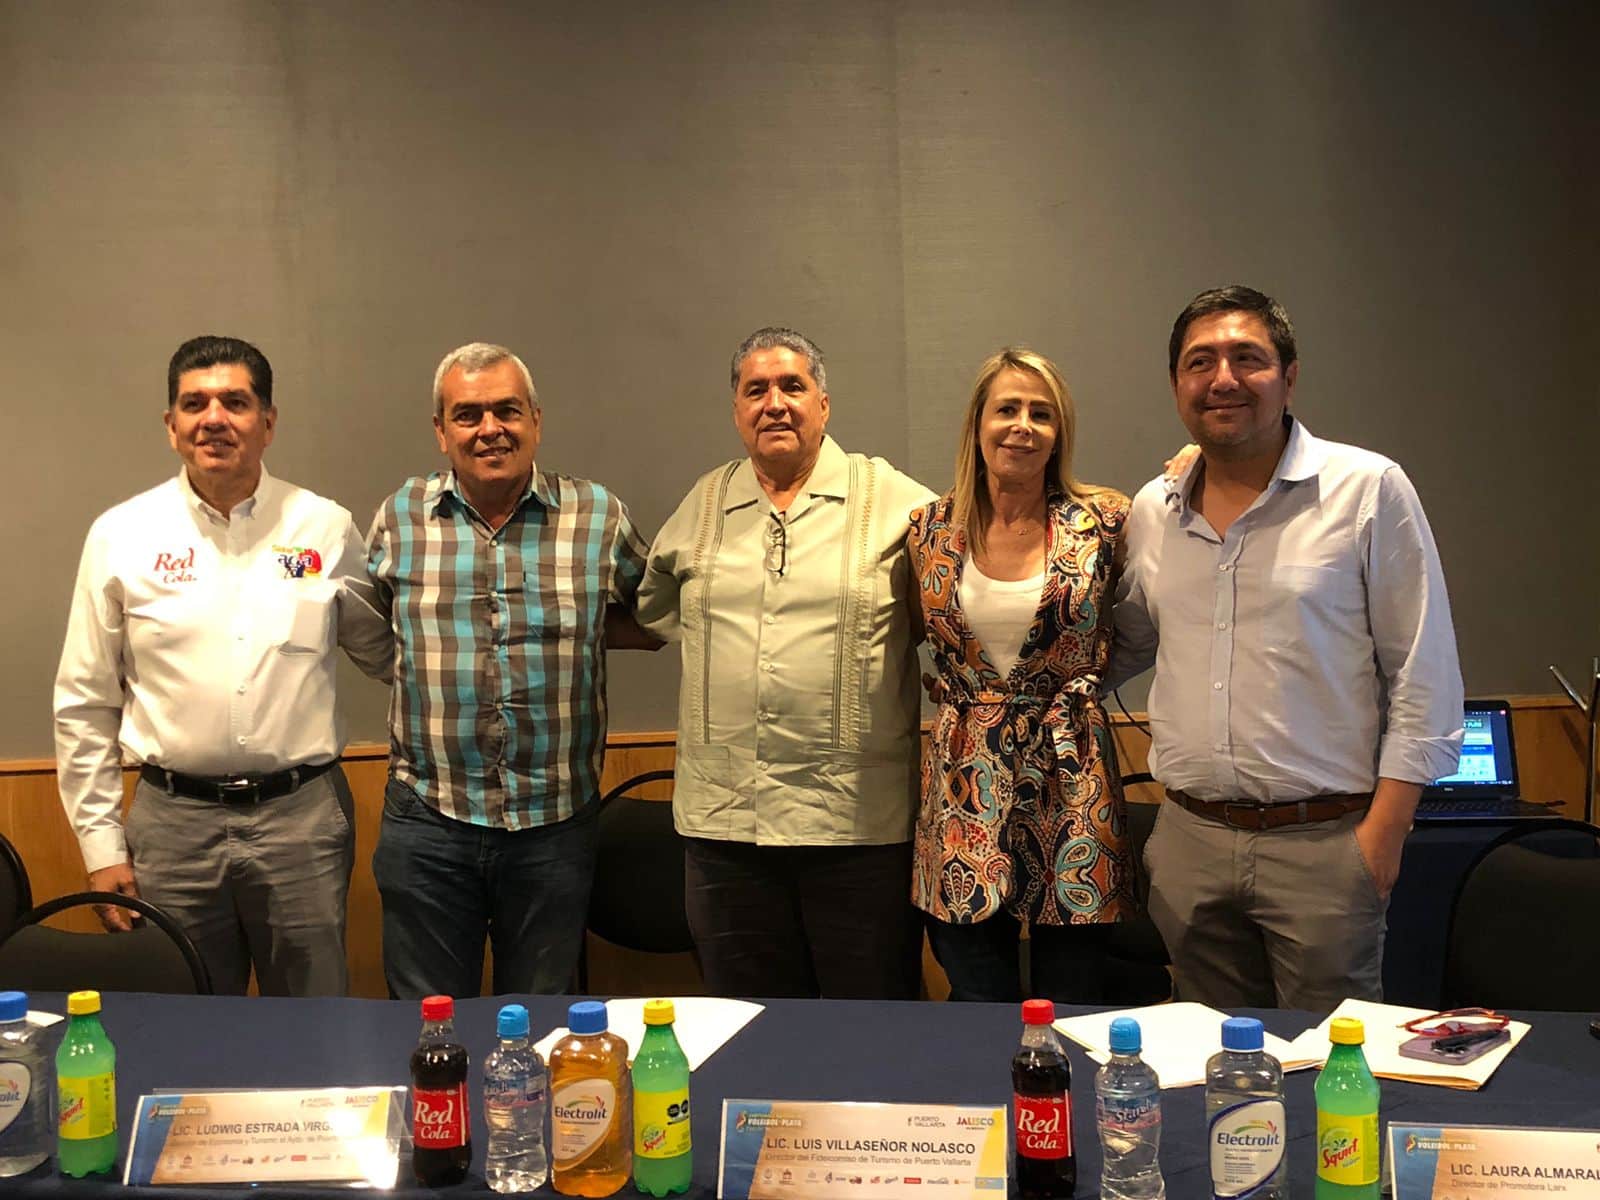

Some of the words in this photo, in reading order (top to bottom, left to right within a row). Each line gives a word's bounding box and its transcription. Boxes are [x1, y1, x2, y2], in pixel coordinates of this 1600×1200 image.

[154, 547, 195, 572] Red
[415, 1100, 454, 1124] Red
[554, 1106, 607, 1119] Electrolit
[956, 1116, 995, 1126] JALISCO
[1017, 1108, 1060, 1133] Red
[197, 1124, 242, 1135] LUDWIG
[245, 1122, 299, 1133] ESTRADA
[304, 1121, 333, 1132] VIRG
[420, 1125, 450, 1139] Cola
[767, 1138, 790, 1149] LIC.
[794, 1139, 822, 1150] LUIS
[826, 1139, 908, 1152] VILLASEÑOR
[912, 1142, 975, 1154] NOLASCO
[1026, 1135, 1057, 1149] Cola
[1217, 1132, 1280, 1146] Electrolit
[858, 1155, 868, 1163] de
[870, 1156, 900, 1164] Turismo
[915, 1157, 940, 1165] Puerto
[942, 1157, 971, 1166] Vallarta
[1323, 1138, 1358, 1169] Squirt
[1450, 1164, 1477, 1176] LIC.
[1481, 1165, 1530, 1177] LAURA
